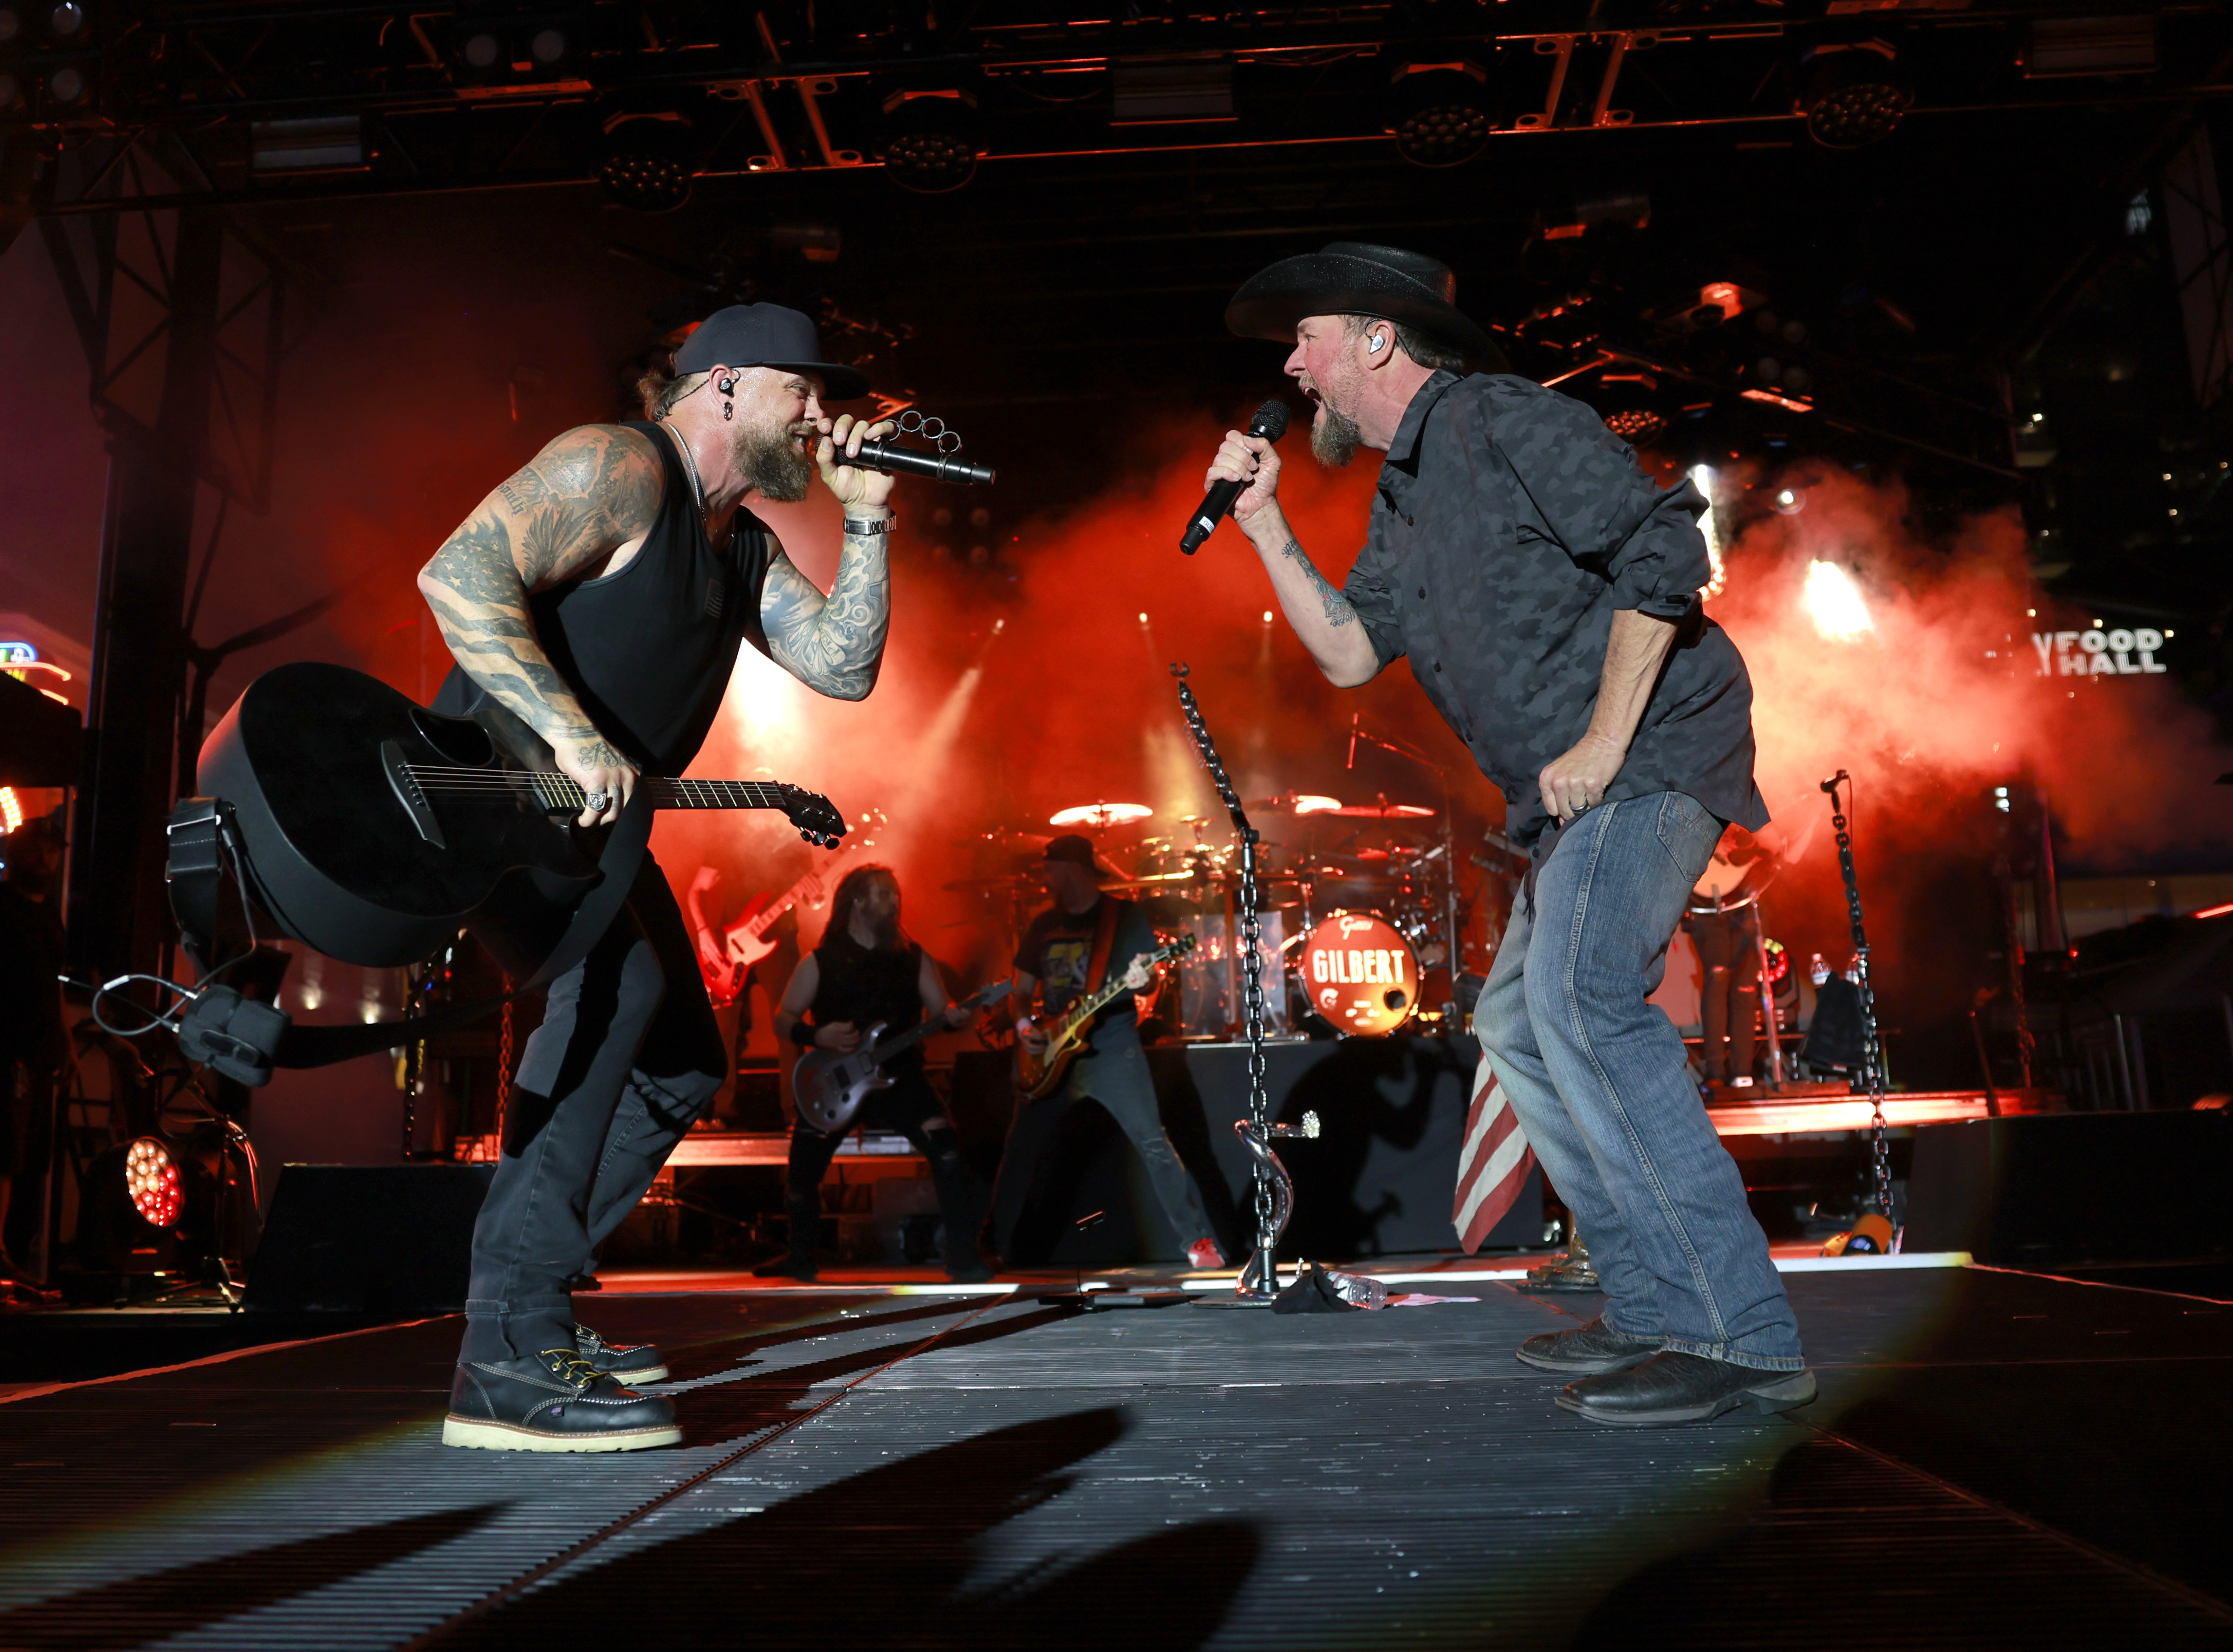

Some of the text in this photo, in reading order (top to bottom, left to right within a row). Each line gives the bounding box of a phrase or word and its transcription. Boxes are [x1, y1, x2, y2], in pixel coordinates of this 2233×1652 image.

[2055, 628, 2163, 653] FOOD
[2060, 652, 2167, 676] HALL
[1312, 949, 1405, 983] GILBERT
